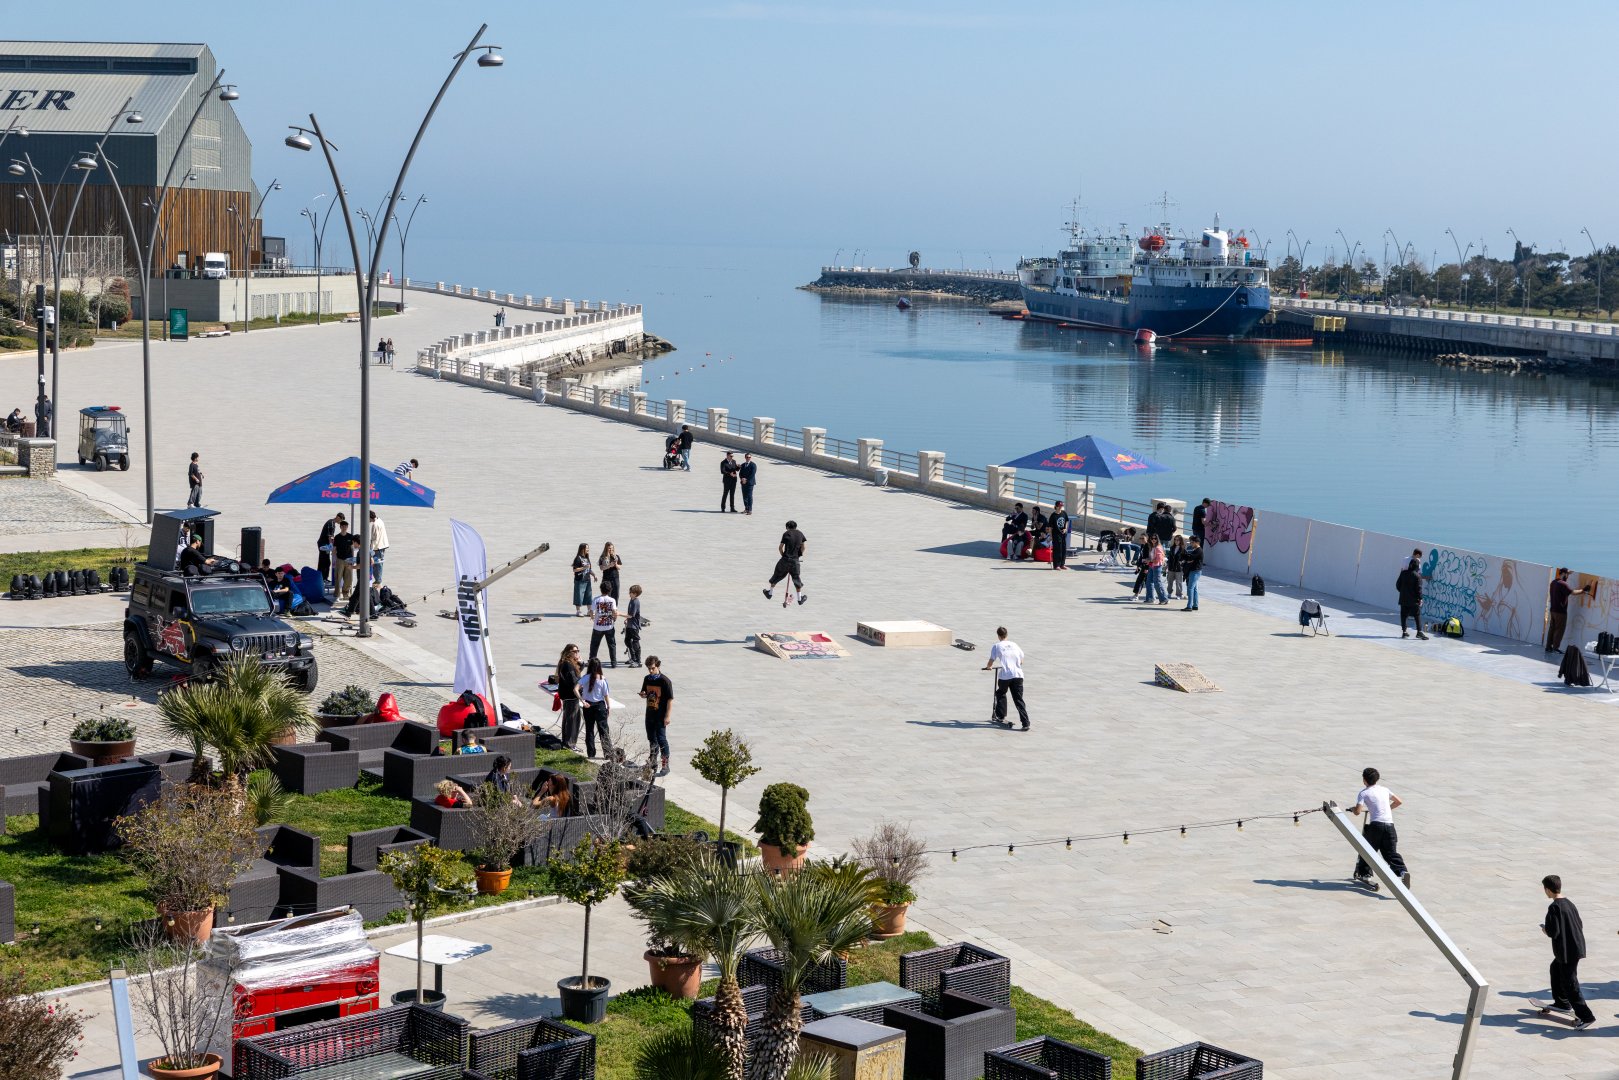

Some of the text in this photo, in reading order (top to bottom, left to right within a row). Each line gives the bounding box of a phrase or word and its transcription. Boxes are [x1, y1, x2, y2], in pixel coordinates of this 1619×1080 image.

[0, 89, 76, 110] ER
[321, 490, 380, 499] Red Bll
